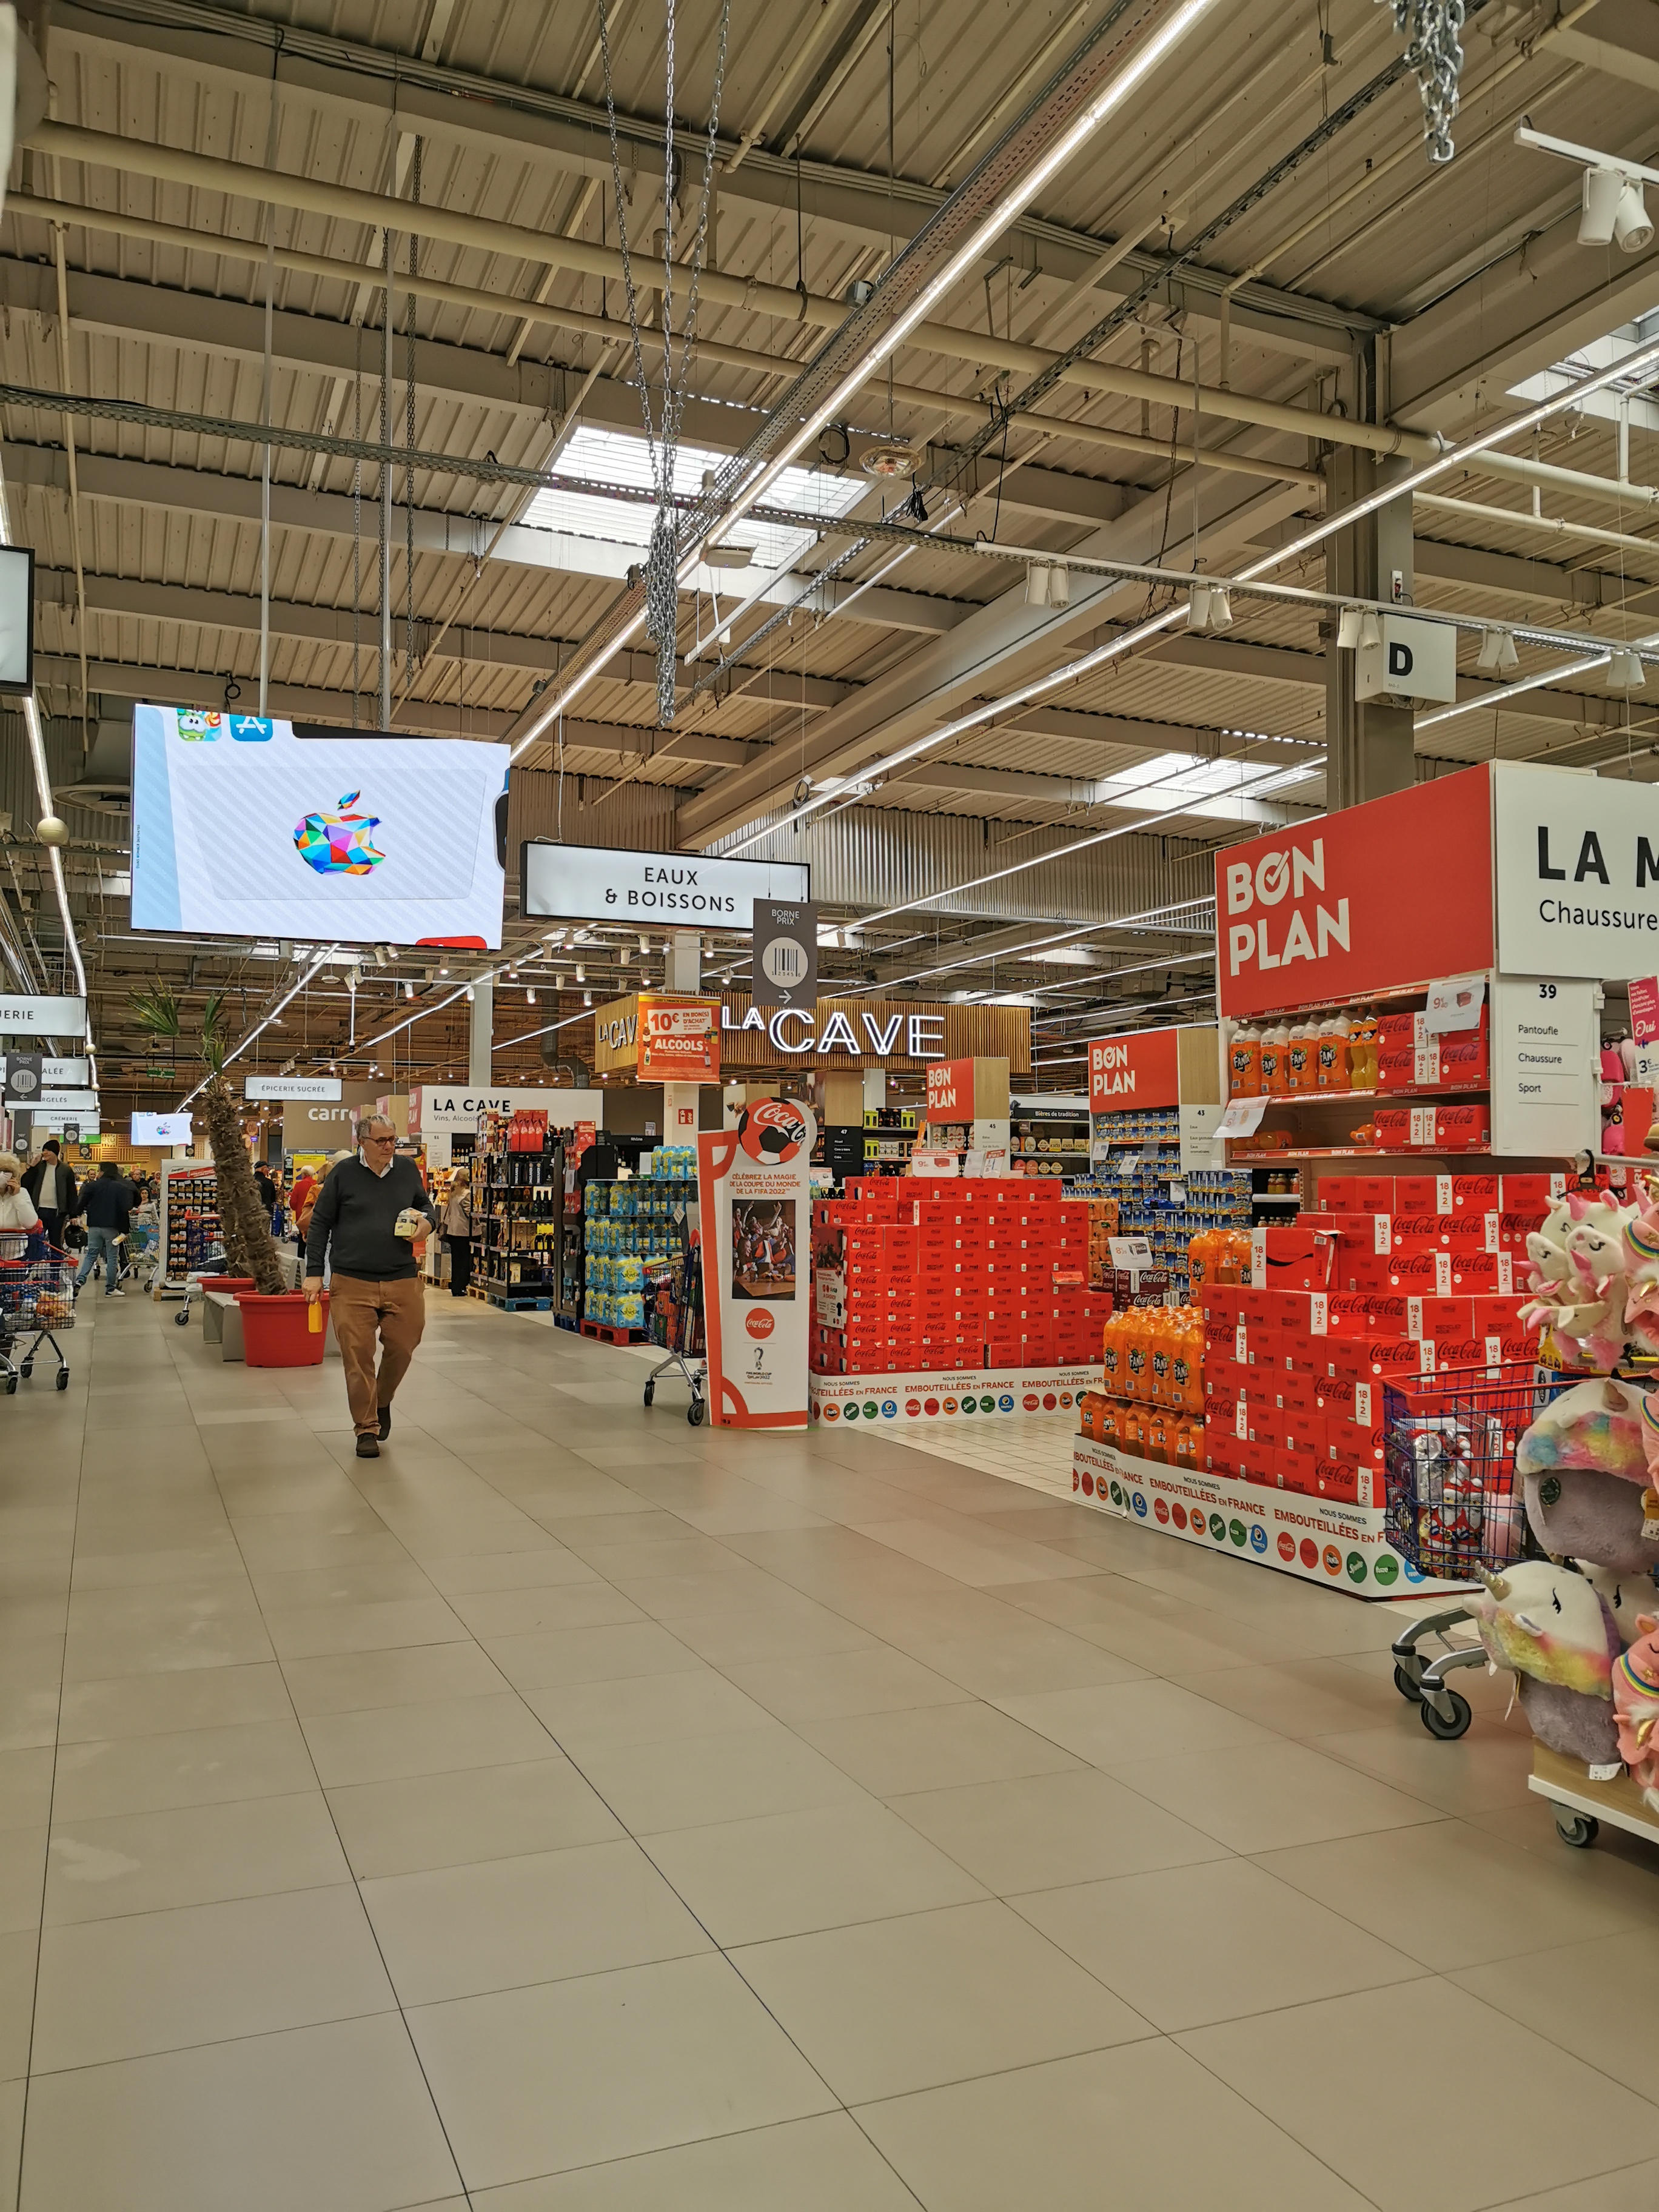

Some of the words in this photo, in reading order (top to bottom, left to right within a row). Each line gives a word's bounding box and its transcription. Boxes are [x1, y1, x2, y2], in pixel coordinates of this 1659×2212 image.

[1389, 642, 1413, 676] D
[1538, 826, 1610, 885] LA
[645, 867, 698, 886] EAUX
[1227, 838, 1325, 916] BON
[605, 888, 617, 903] &
[628, 890, 735, 912] BOISSONS
[771, 909, 800, 919] BORNE
[777, 917, 795, 926] PRIX
[1229, 897, 1350, 977] PLAN
[1539, 984, 1557, 999] 39
[598, 1023, 609, 1042] LA
[722, 1005, 766, 1031] LA
[768, 1008, 945, 1058] CAVE
[1518, 1025, 1559, 1036] Pantoufle
[1635, 1021, 1656, 1037] Oui
[654, 1039, 703, 1051] ALCOOLS
[1093, 1044, 1128, 1071] BON
[1518, 1053, 1563, 1064] Chaussure
[928, 1067, 951, 1088] BON
[1093, 1070, 1136, 1096] PLAN
[1518, 1082, 1541, 1094] Sport
[434, 1099, 455, 1111] LA
[463, 1099, 511, 1112] CAVE
[928, 1088, 956, 1109] PLAN
[1410, 1304, 1419, 1313] 18
[905, 1382, 971, 1393] EMBOUTEILLÉES
[981, 1381, 1014, 1389] FRANCE
[1022, 1377, 1085, 1388] EMBOUTEILLÉES
[864, 1386, 897, 1395] FRANCE
[1358, 1390, 1368, 1398] 18
[1360, 1406, 1366, 1415] 2
[1183, 1476, 1197, 1485] NOUS
[1198, 1480, 1221, 1490] SOMMES
[1360, 1475, 1370, 1484] 18
[1149, 1477, 1216, 1504] EMBOUTEILLÉES
[1218, 1497, 1227, 1507] EN
[1228, 1496, 1266, 1517] FRANCE
[1362, 1492, 1368, 1500] 2
[1319, 1507, 1337, 1518] NOUS
[1338, 1511, 1367, 1524] SOMMES
[1274, 1508, 1359, 1540] EMBOUTEILLÉES
[1361, 1533, 1375, 1543] EN
